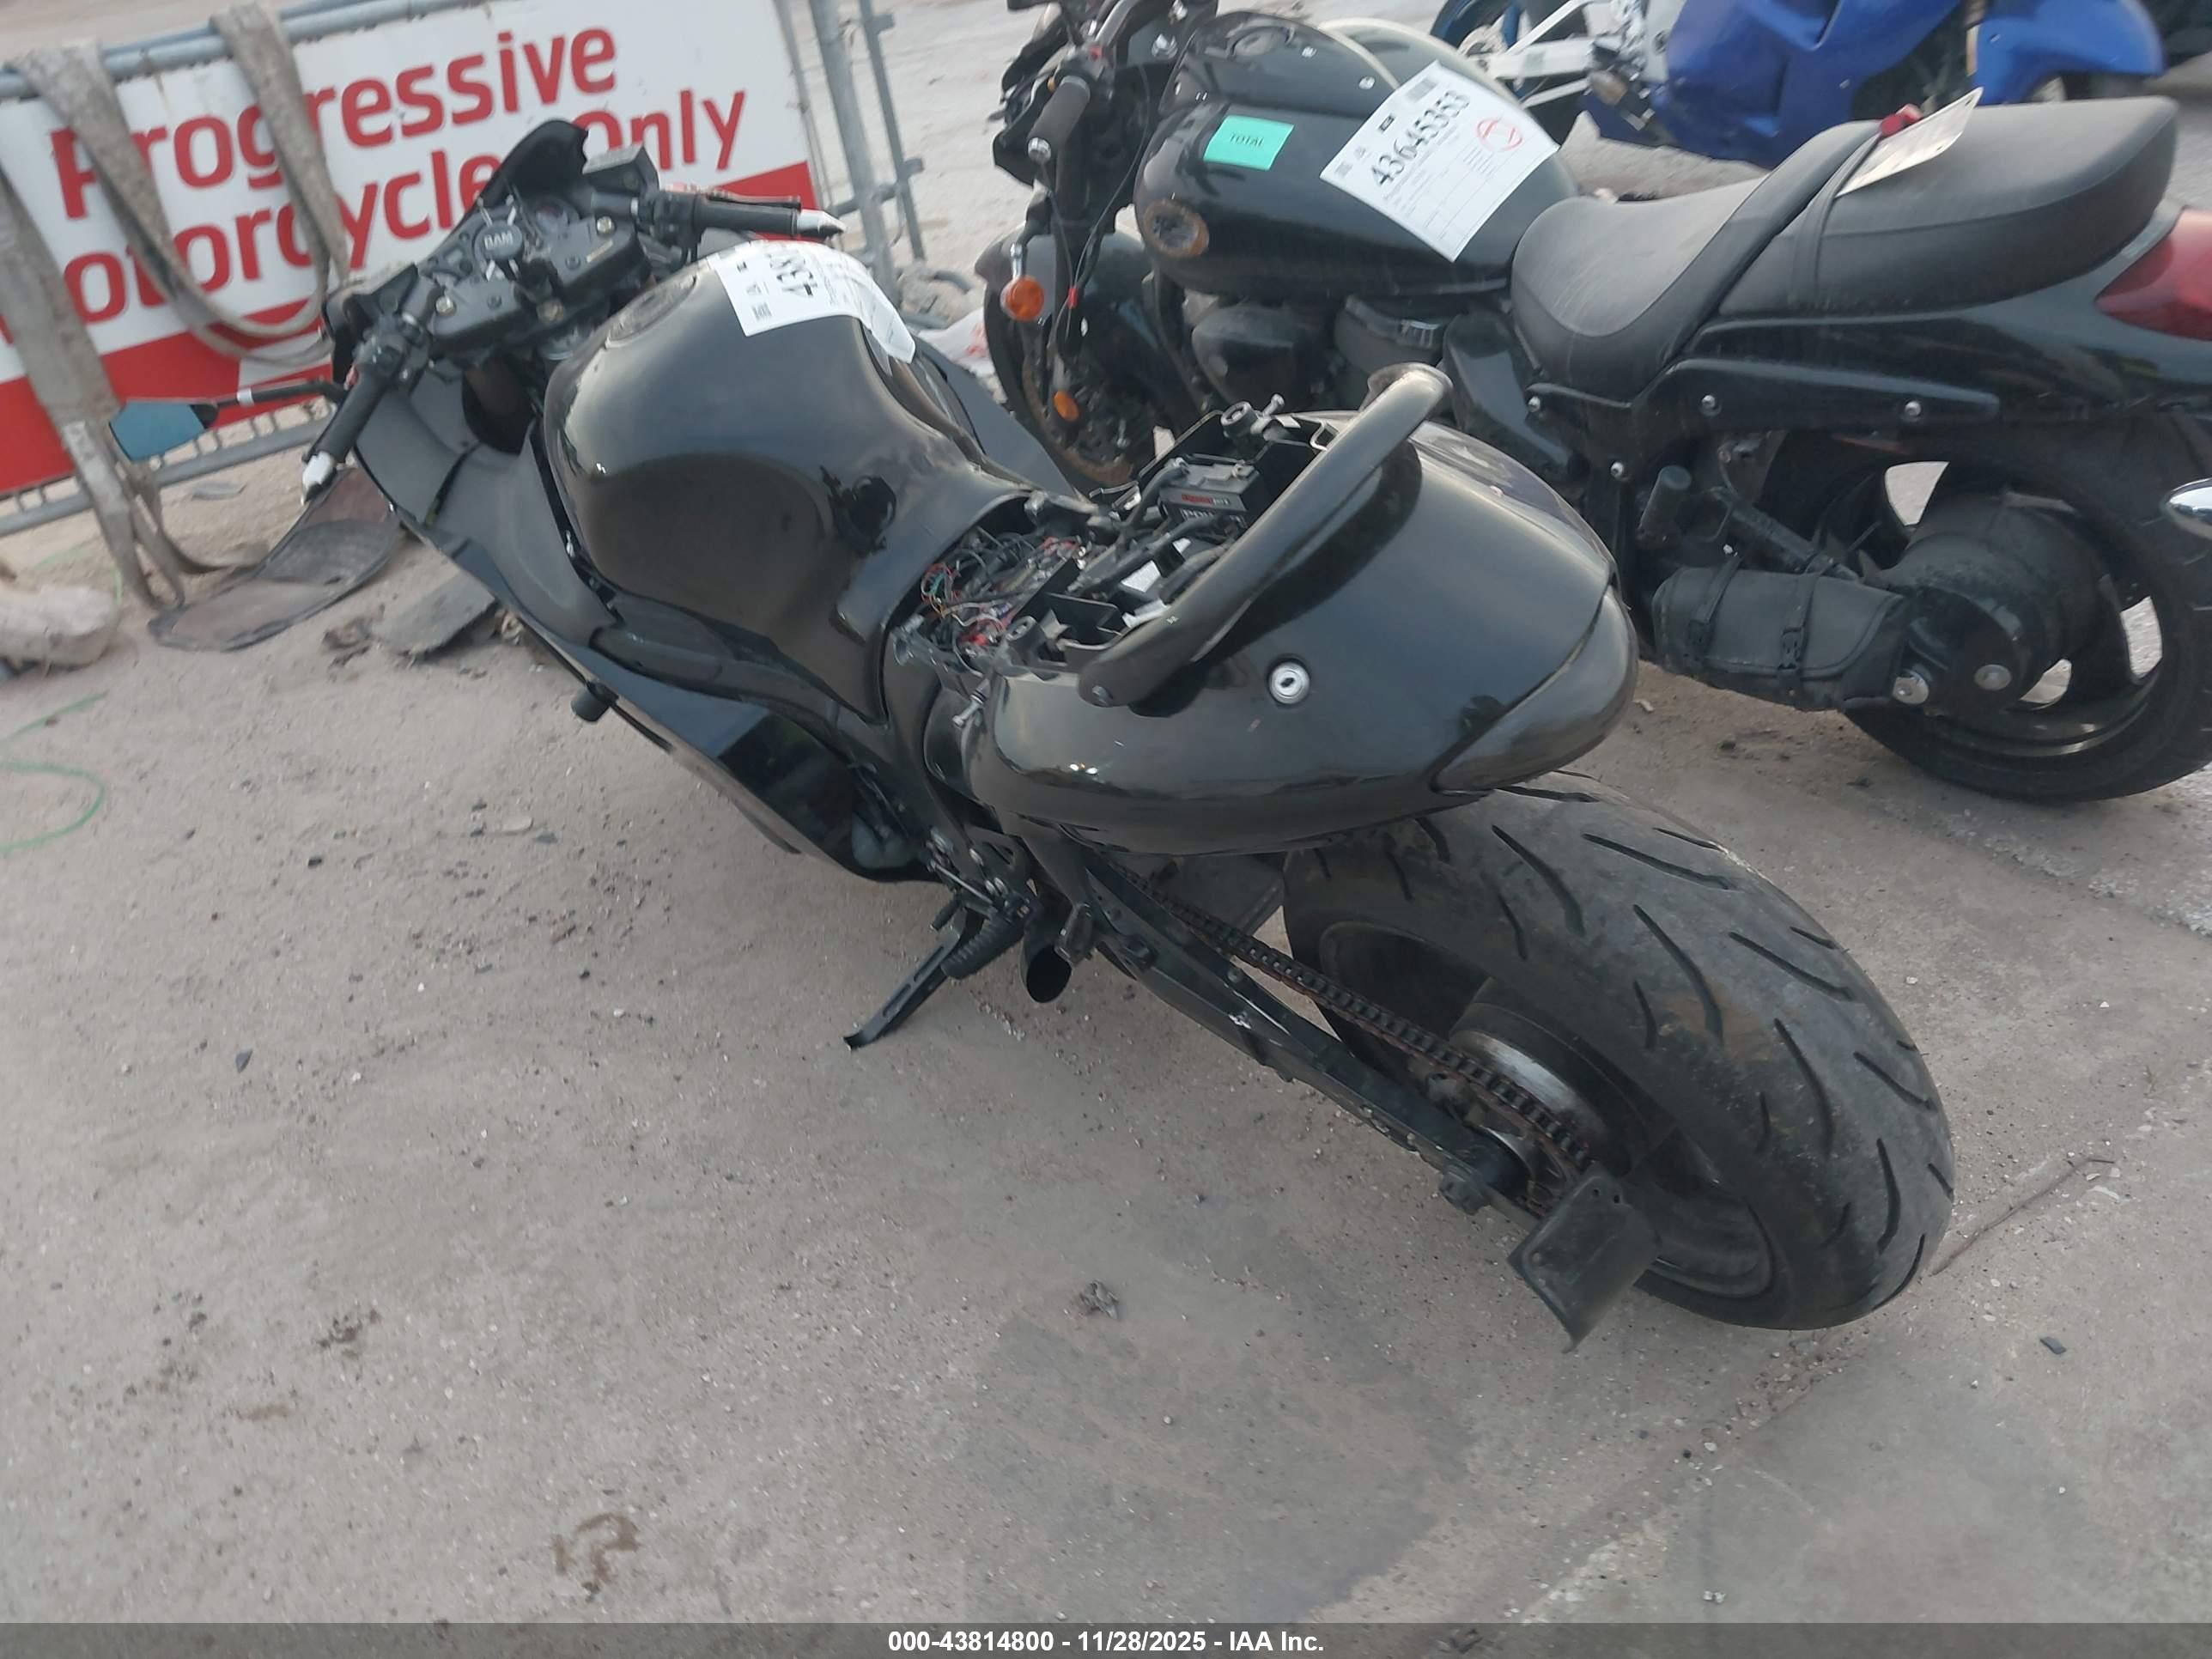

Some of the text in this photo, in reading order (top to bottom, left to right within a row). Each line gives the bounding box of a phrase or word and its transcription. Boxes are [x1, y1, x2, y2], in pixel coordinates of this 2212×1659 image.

[50, 28, 616, 222] Progressive
[1229, 132, 1264, 147] TOTAL
[1370, 90, 1470, 186] 43645353
